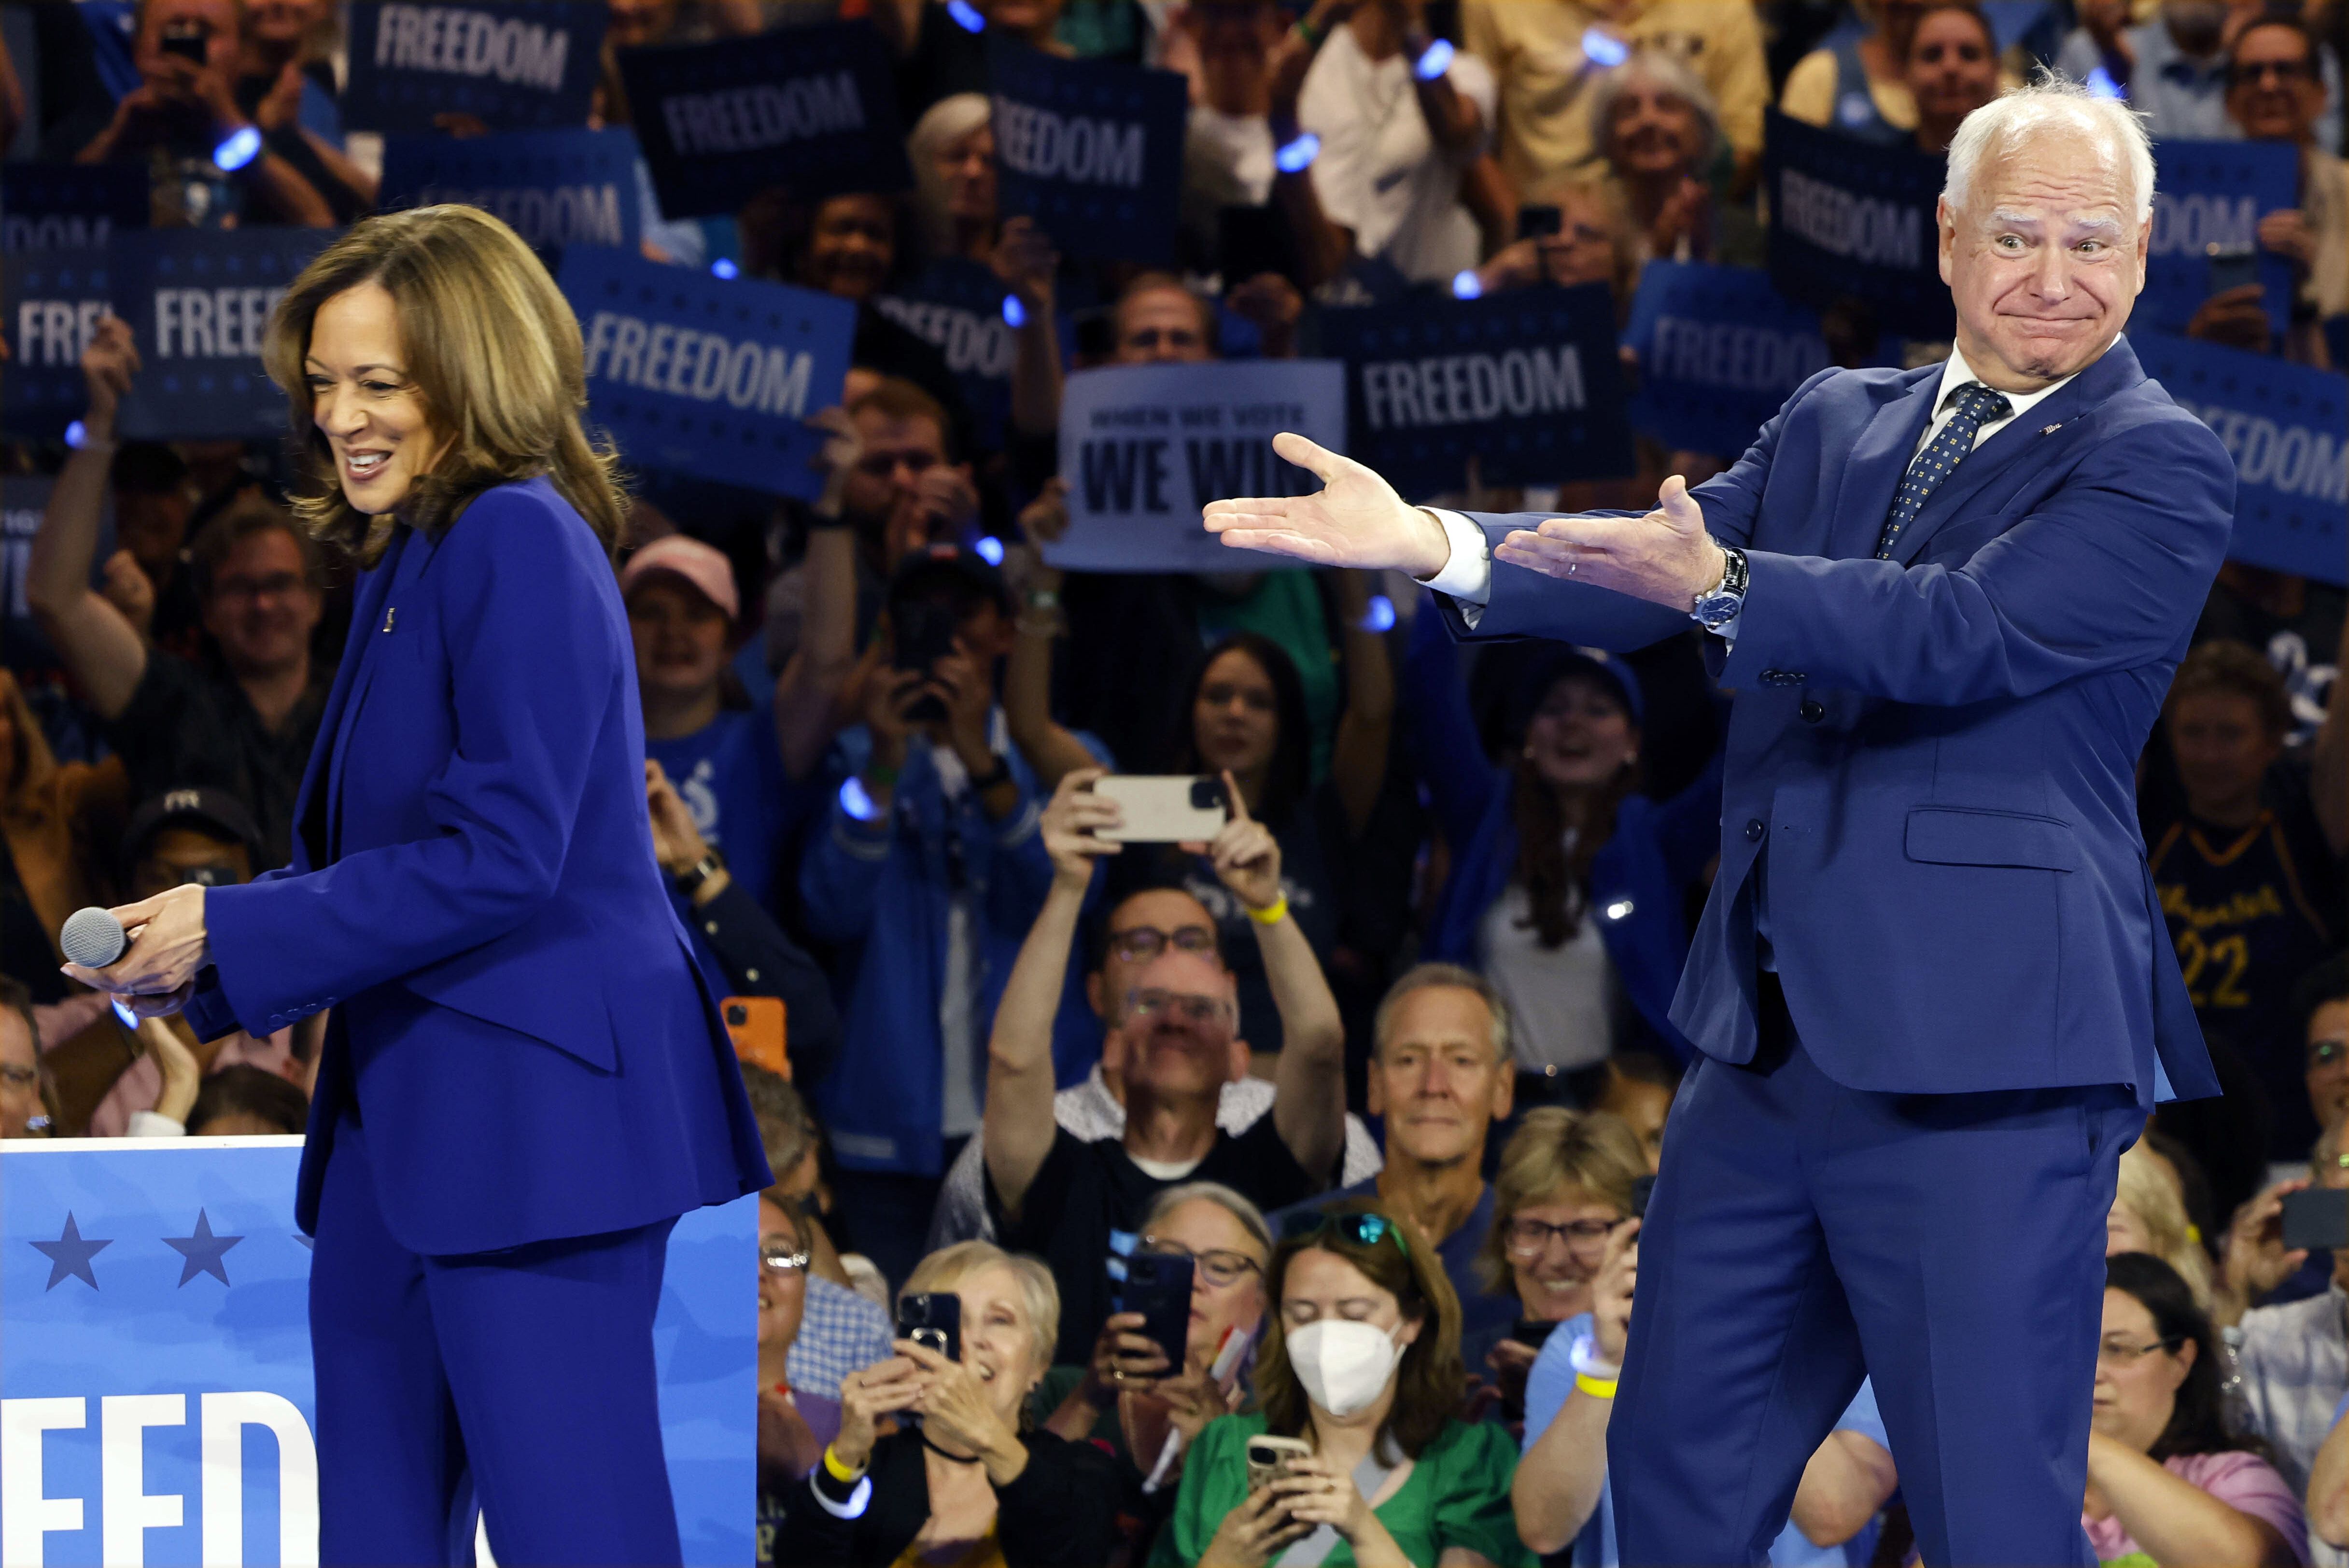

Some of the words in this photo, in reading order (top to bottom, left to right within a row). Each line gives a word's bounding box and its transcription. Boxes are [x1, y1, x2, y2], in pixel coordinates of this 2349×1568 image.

[374, 4, 569, 92] FREEDOM
[660, 70, 866, 155] FREEDOM
[583, 311, 814, 418] FREEDOM
[1361, 342, 1588, 429] FREEDOM
[1082, 438, 1169, 515] WE
[2177, 929, 2251, 1007] 22
